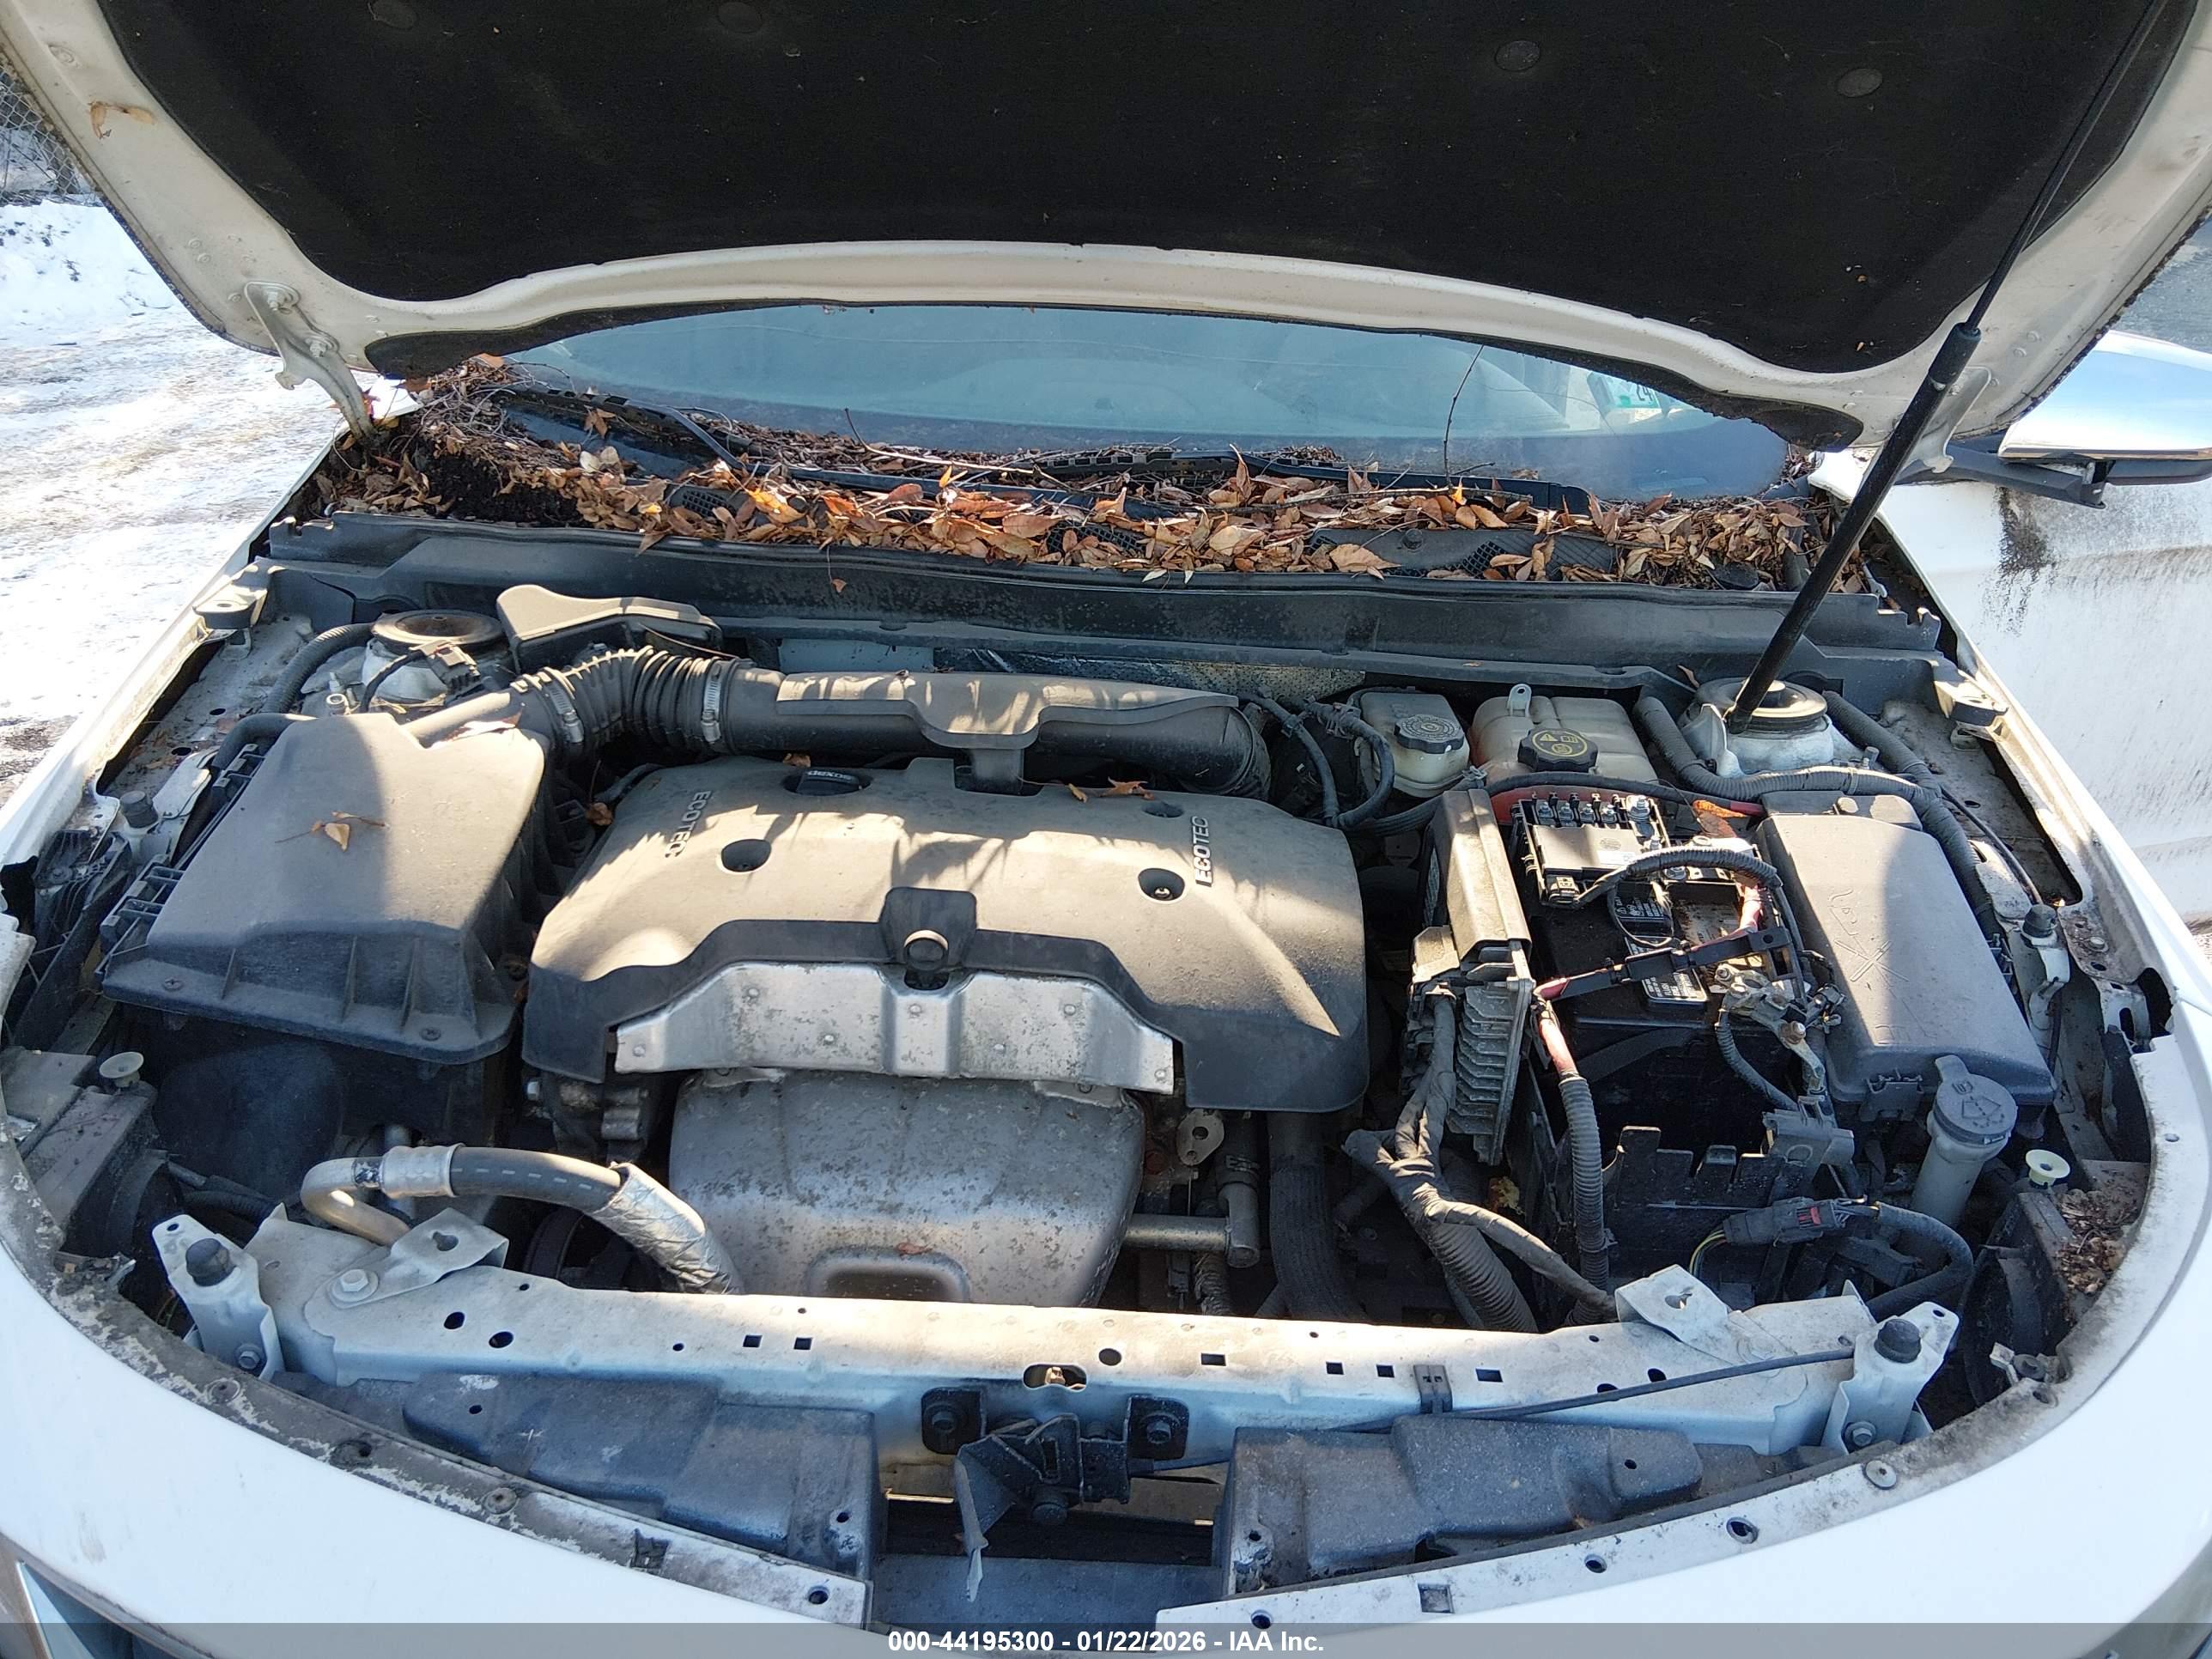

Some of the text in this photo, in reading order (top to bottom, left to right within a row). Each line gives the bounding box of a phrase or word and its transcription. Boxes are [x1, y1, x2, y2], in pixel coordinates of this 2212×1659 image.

[807, 770, 853, 780] dexos
[665, 791, 712, 858] ECOTEC
[1192, 816, 1212, 886] ECOTEC
